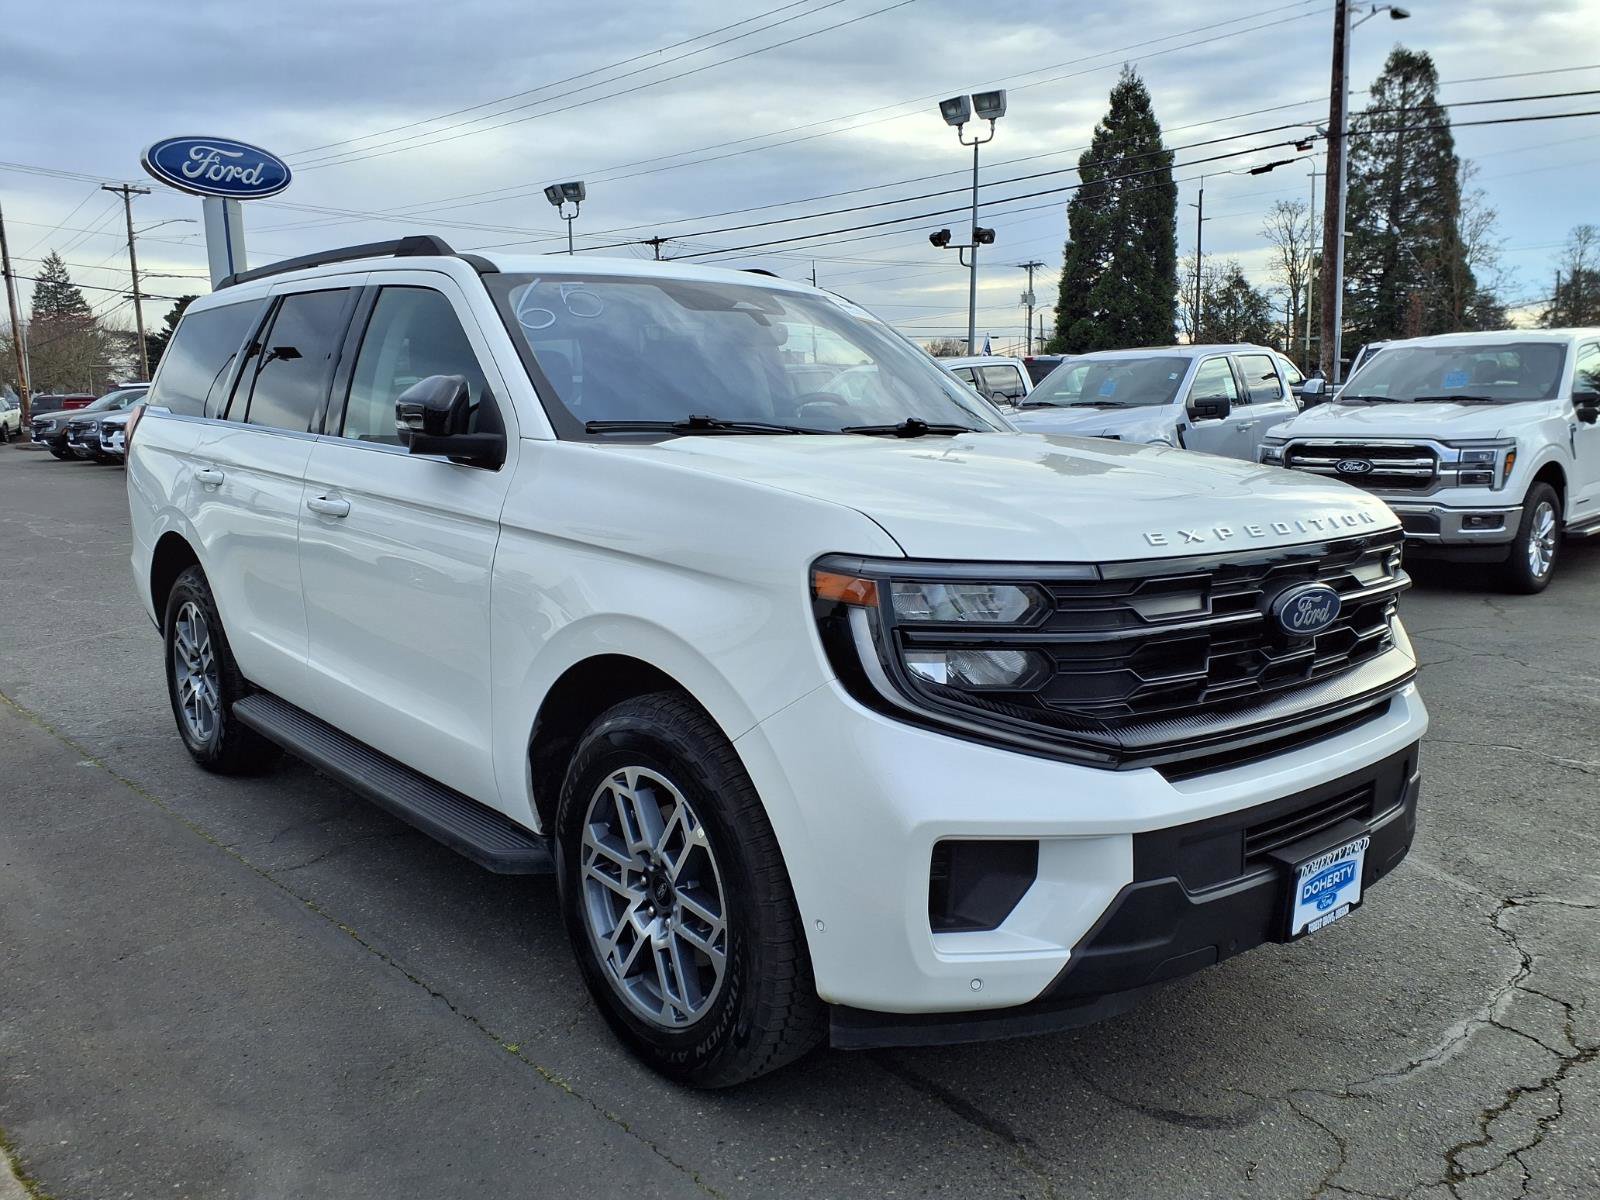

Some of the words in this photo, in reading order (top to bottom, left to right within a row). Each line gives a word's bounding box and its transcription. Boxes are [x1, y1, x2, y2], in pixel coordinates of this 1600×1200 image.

[182, 145, 264, 186] Ford
[516, 277, 604, 329] 65
[1343, 461, 1365, 471] Ford
[1143, 511, 1376, 546] EXPEDITION
[1293, 595, 1331, 628] Ford
[1303, 863, 1354, 898] DOHERTY
